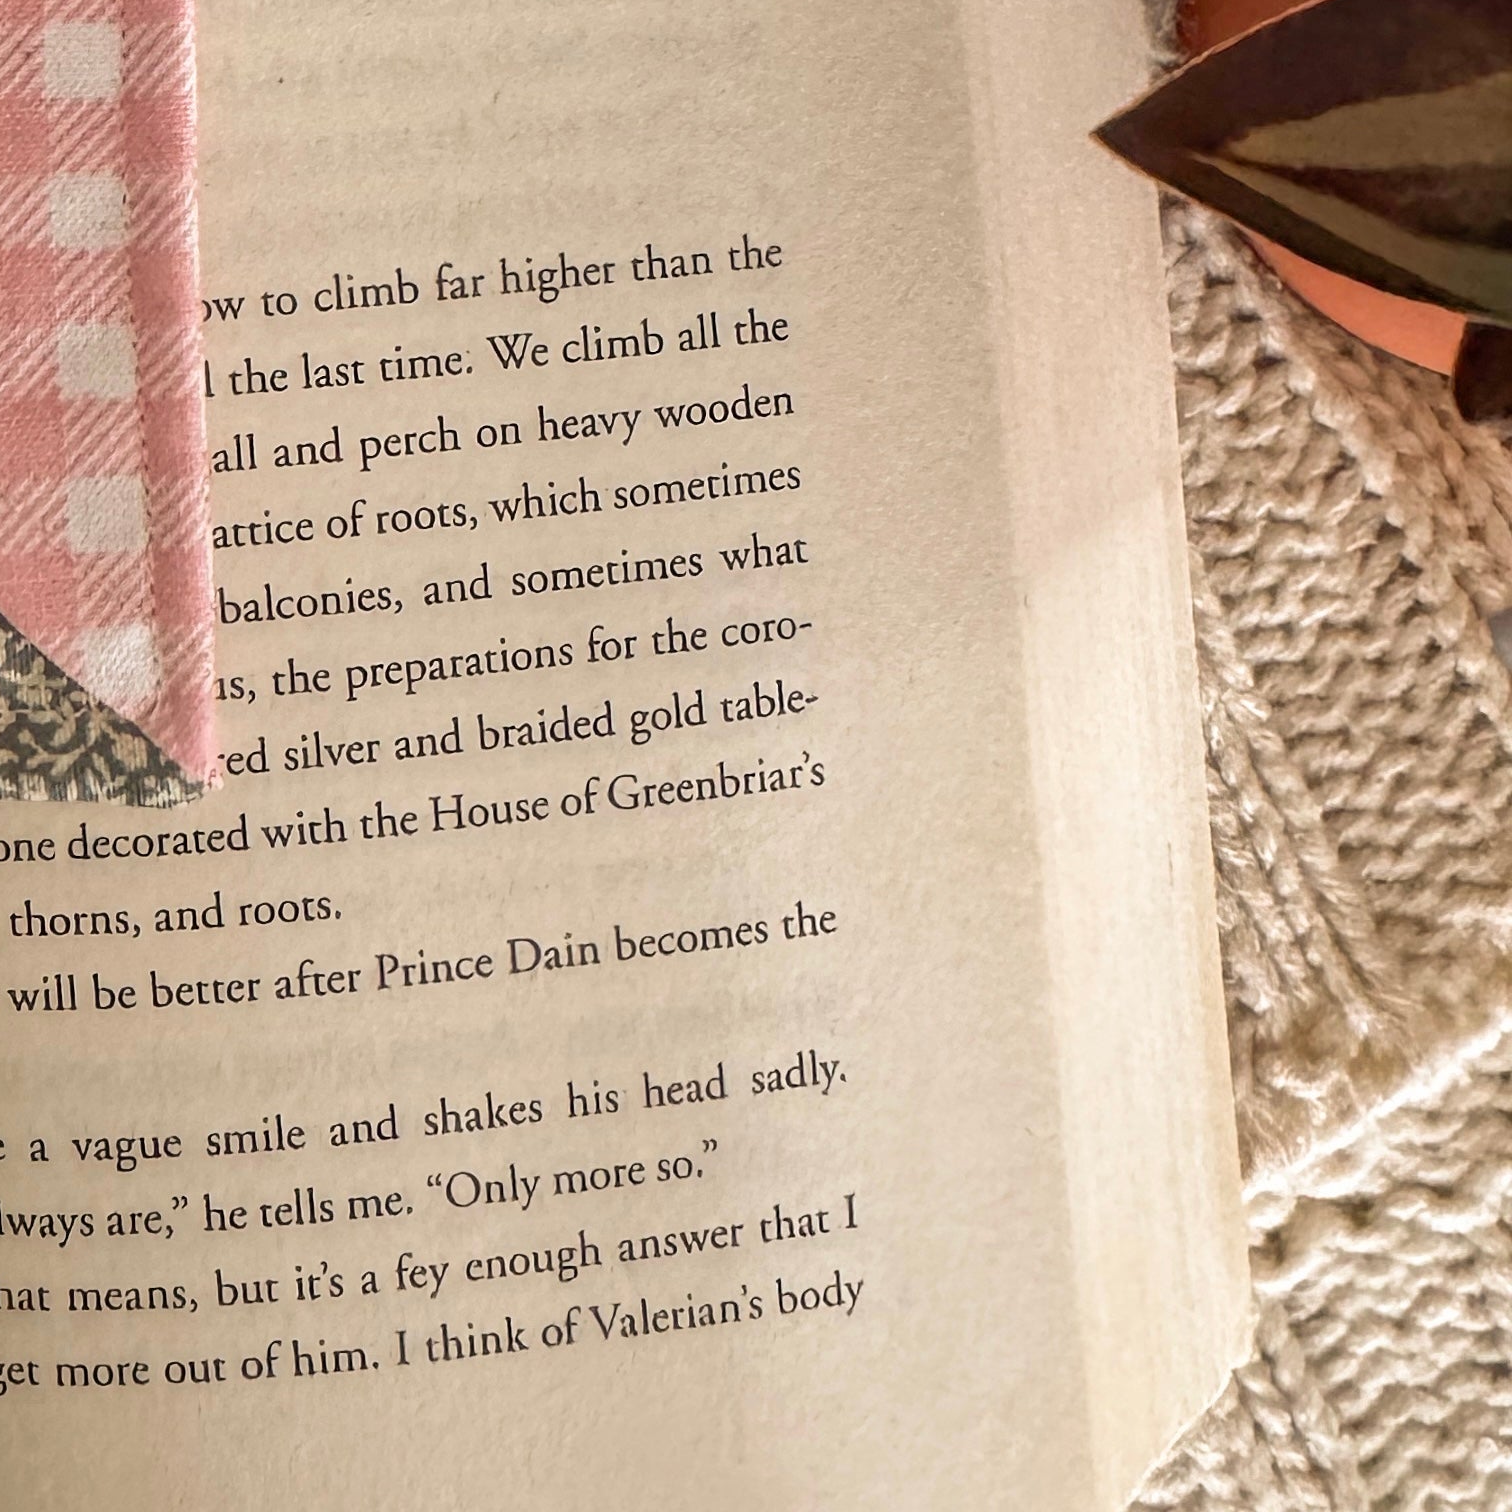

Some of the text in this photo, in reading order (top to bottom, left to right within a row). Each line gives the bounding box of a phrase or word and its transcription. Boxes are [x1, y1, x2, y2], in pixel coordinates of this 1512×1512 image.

[261, 233, 782, 316] to climb far higher than the
[229, 308, 788, 395] the last time. We climb all the
[272, 617, 812, 701] the preparations for the coro-
[284, 680, 818, 771] silver and braided gold table-
[68, 813, 250, 859] decorated
[261, 807, 347, 848] with
[360, 801, 418, 839] the
[429, 794, 549, 831] House
[561, 777, 600, 816] of
[608, 751, 824, 809] Greenbriar’s
[7, 974, 77, 1011] will
[93, 973, 136, 1009] be
[150, 971, 260, 1007] better
[275, 959, 361, 999] after
[375, 950, 493, 990] Prince
[507, 933, 600, 974] Dain
[614, 921, 768, 960] becomes
[782, 901, 837, 939] the
[10, 900, 140, 938] thorns,
[155, 891, 225, 932] and
[239, 897, 341, 926] roots.
[107, 1196, 187, 1239] are,”
[203, 1193, 247, 1231] he
[260, 1187, 333, 1227] tells
[348, 1193, 413, 1219] me.
[427, 1164, 540, 1211] “Only
[554, 1163, 645, 1195] more
[657, 1139, 717, 1181] so.”
[69, 1286, 197, 1313] means,
[215, 1269, 278, 1306] but
[295, 1261, 343, 1300] it’s
[361, 1271, 380, 1295] a
[396, 1253, 449, 1299] fey
[466, 1230, 602, 1282] enough
[618, 1224, 744, 1262] answer
[760, 1204, 830, 1243] that
[844, 1193, 857, 1228] I
[57, 1362, 149, 1386] more
[165, 1359, 226, 1383] out
[241, 1340, 282, 1379] of
[292, 1340, 379, 1376] him.
[396, 1331, 410, 1365] I
[426, 1317, 529, 1362] think
[542, 1306, 583, 1348] of
[588, 1285, 764, 1343] Valerian’s
[776, 1270, 863, 1316] body
